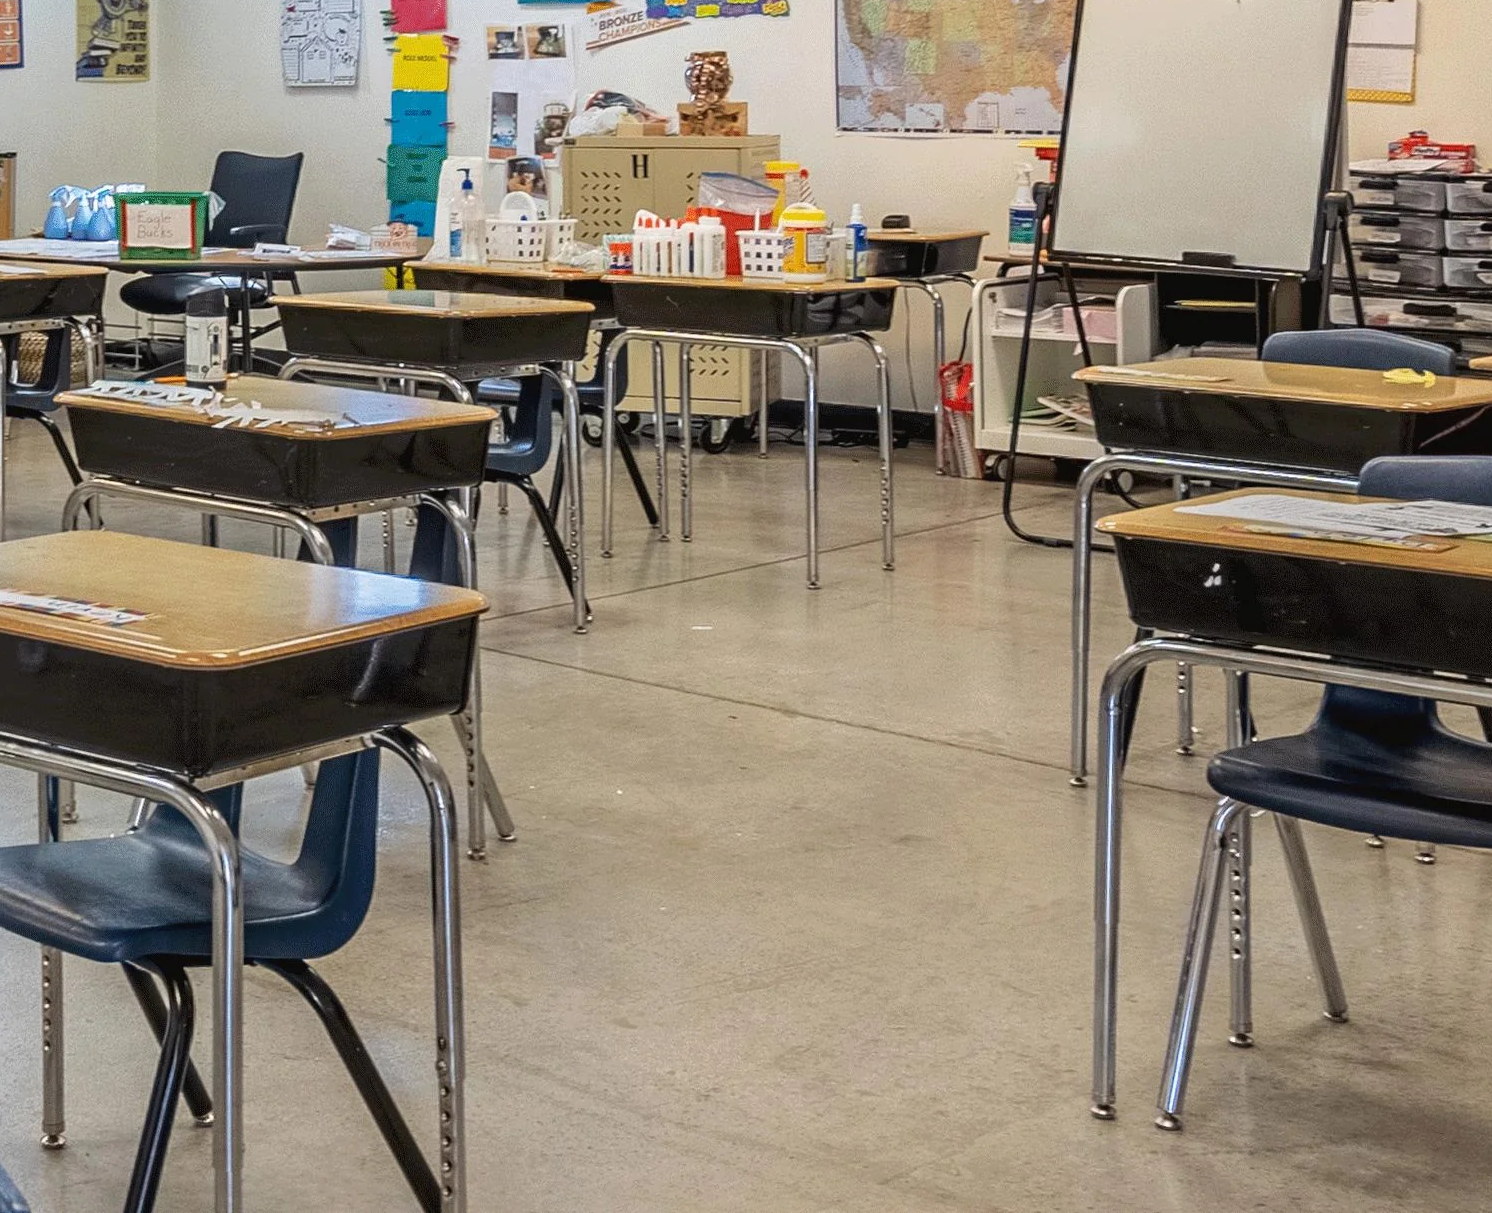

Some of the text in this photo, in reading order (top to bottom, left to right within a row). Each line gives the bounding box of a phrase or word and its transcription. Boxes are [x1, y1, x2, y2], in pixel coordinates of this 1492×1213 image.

[599, 11, 644, 30] BRONZE
[598, 21, 662, 41] CHAMPIONS
[631, 154, 649, 178] H
[137, 210, 171, 227] Eagle
[137, 226, 173, 238] Bucks
